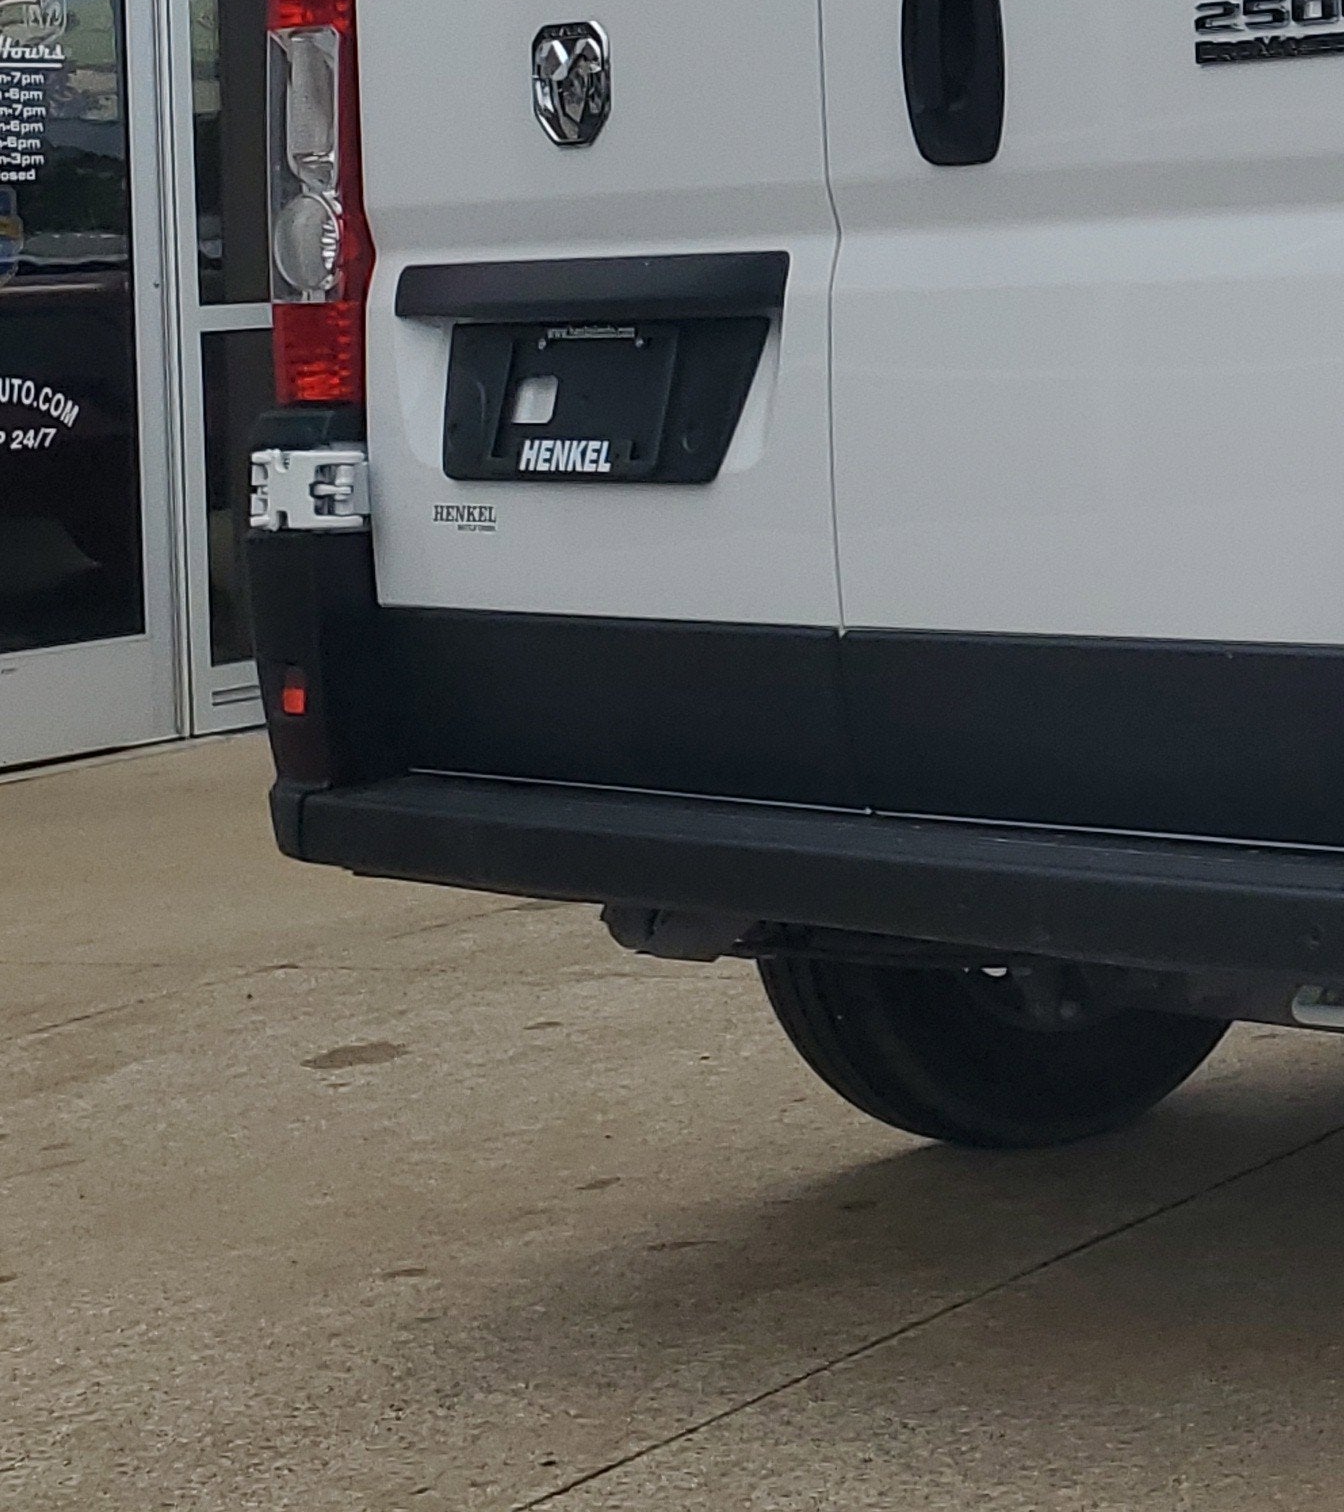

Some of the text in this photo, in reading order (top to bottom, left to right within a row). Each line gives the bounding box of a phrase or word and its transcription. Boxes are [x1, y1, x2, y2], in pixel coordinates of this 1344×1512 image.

[10, 427, 57, 449] 24/7
[518, 439, 611, 473] HENKEL
[433, 505, 496, 523] HENKEL
